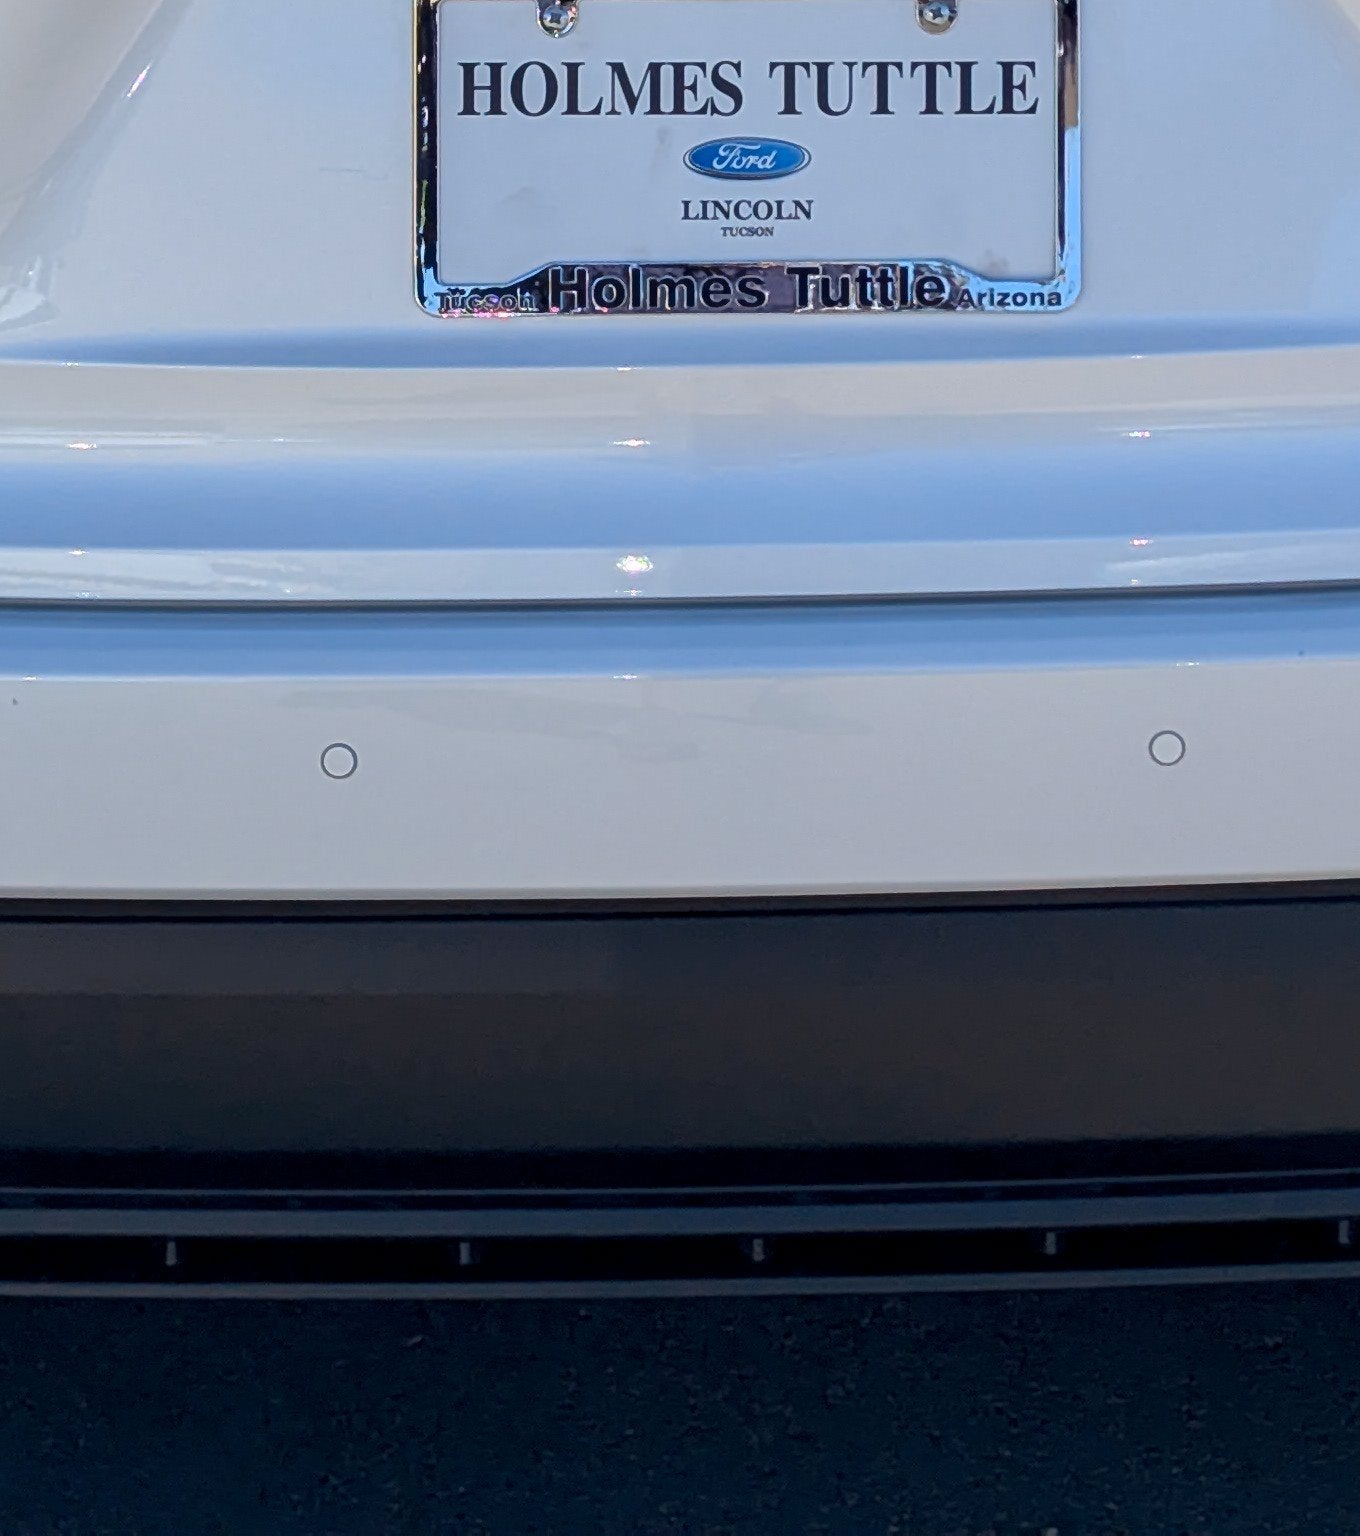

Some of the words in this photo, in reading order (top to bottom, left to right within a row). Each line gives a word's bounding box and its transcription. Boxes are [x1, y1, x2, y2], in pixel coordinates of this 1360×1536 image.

[456, 60, 743, 117] HOLMES
[768, 60, 1040, 117] TUTTLE
[712, 142, 778, 170] Ford
[681, 199, 814, 221] LINCOLN
[720, 226, 775, 237] TUCSON
[438, 287, 539, 313] Tucson
[548, 265, 768, 311] Holmes
[784, 264, 947, 311] Tuttle
[955, 286, 1063, 309] Arizona
